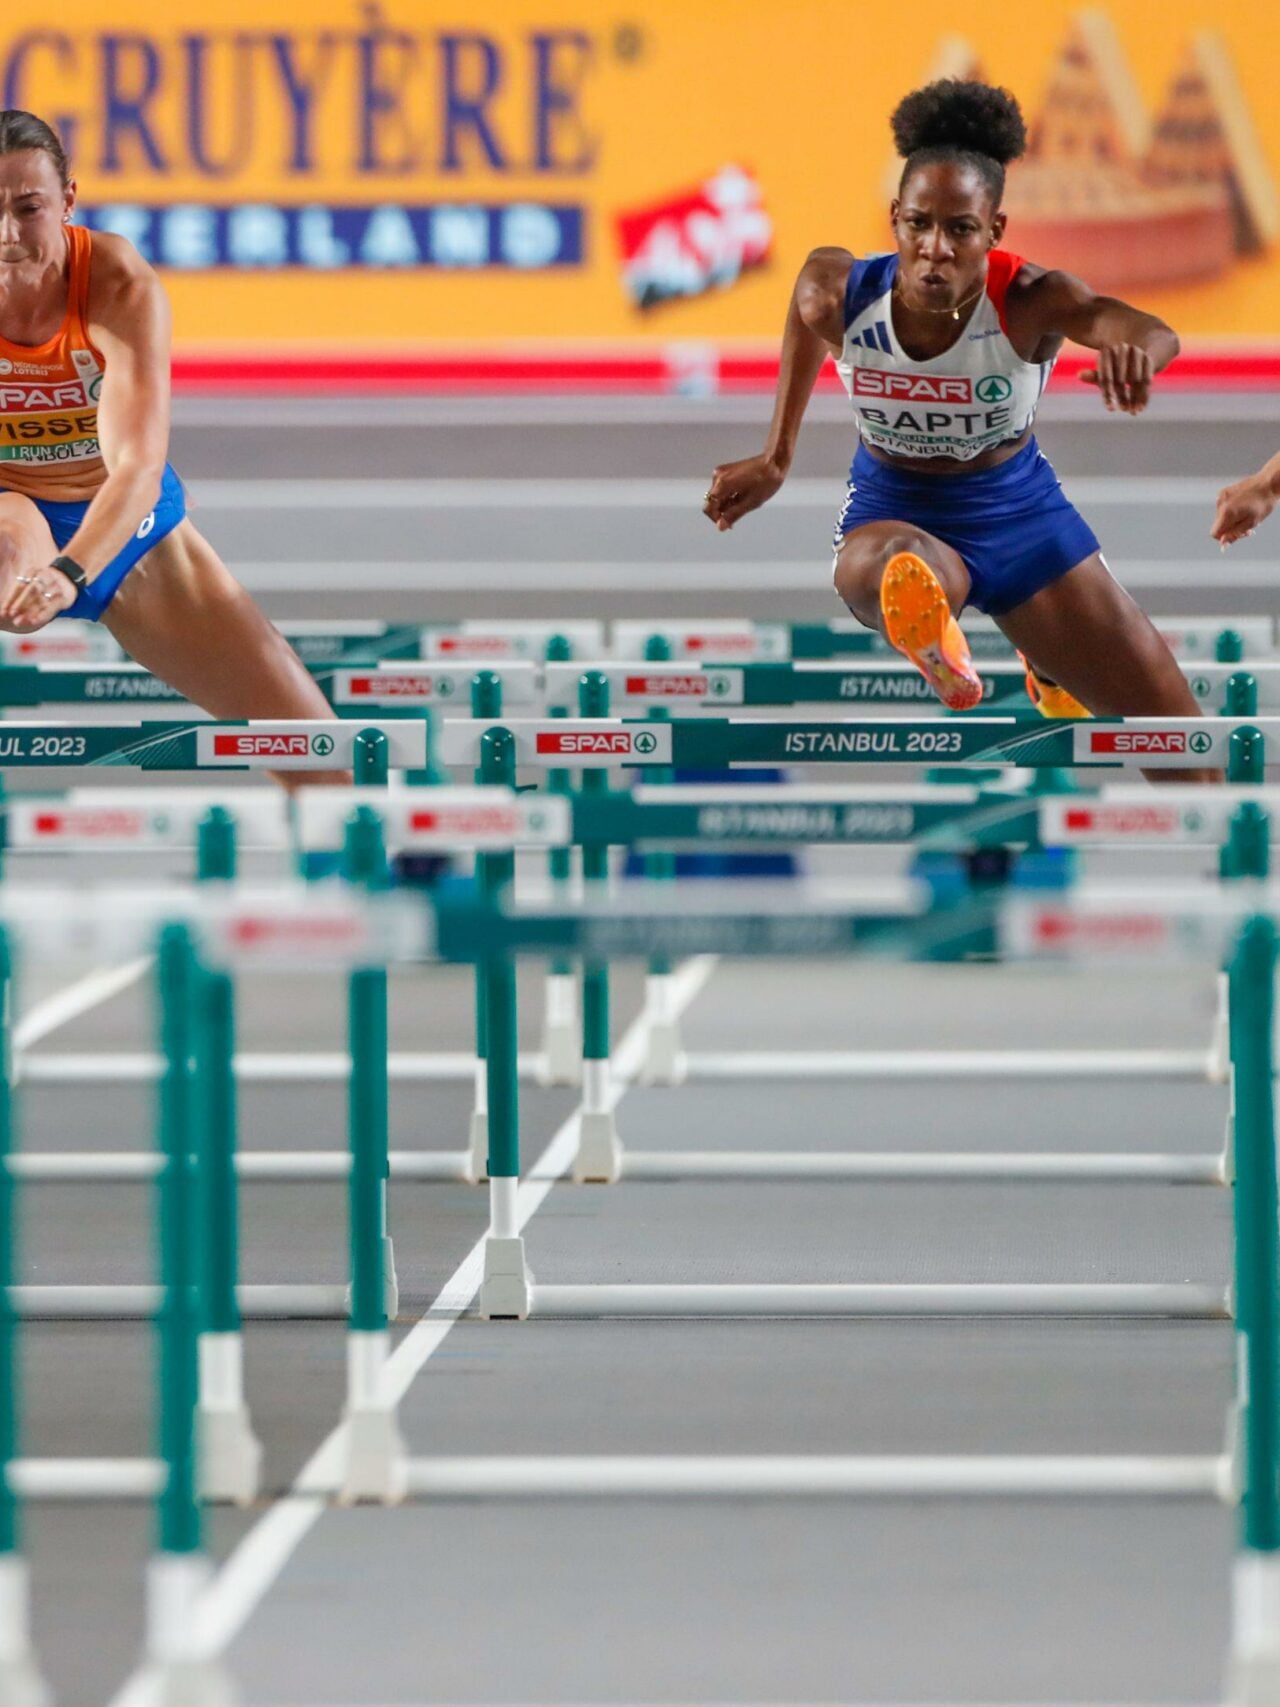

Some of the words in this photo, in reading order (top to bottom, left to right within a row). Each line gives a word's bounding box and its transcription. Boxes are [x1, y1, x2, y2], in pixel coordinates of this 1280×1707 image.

[857, 372, 969, 400] SPAR
[859, 406, 1010, 435] BAPTÉ
[30, 737, 86, 756] 2023
[237, 737, 307, 753] SPAR
[559, 735, 630, 751] SPAR
[785, 733, 900, 752] ISTANBUL
[906, 732, 962, 752] 2023
[1114, 735, 1185, 751] SPAR
